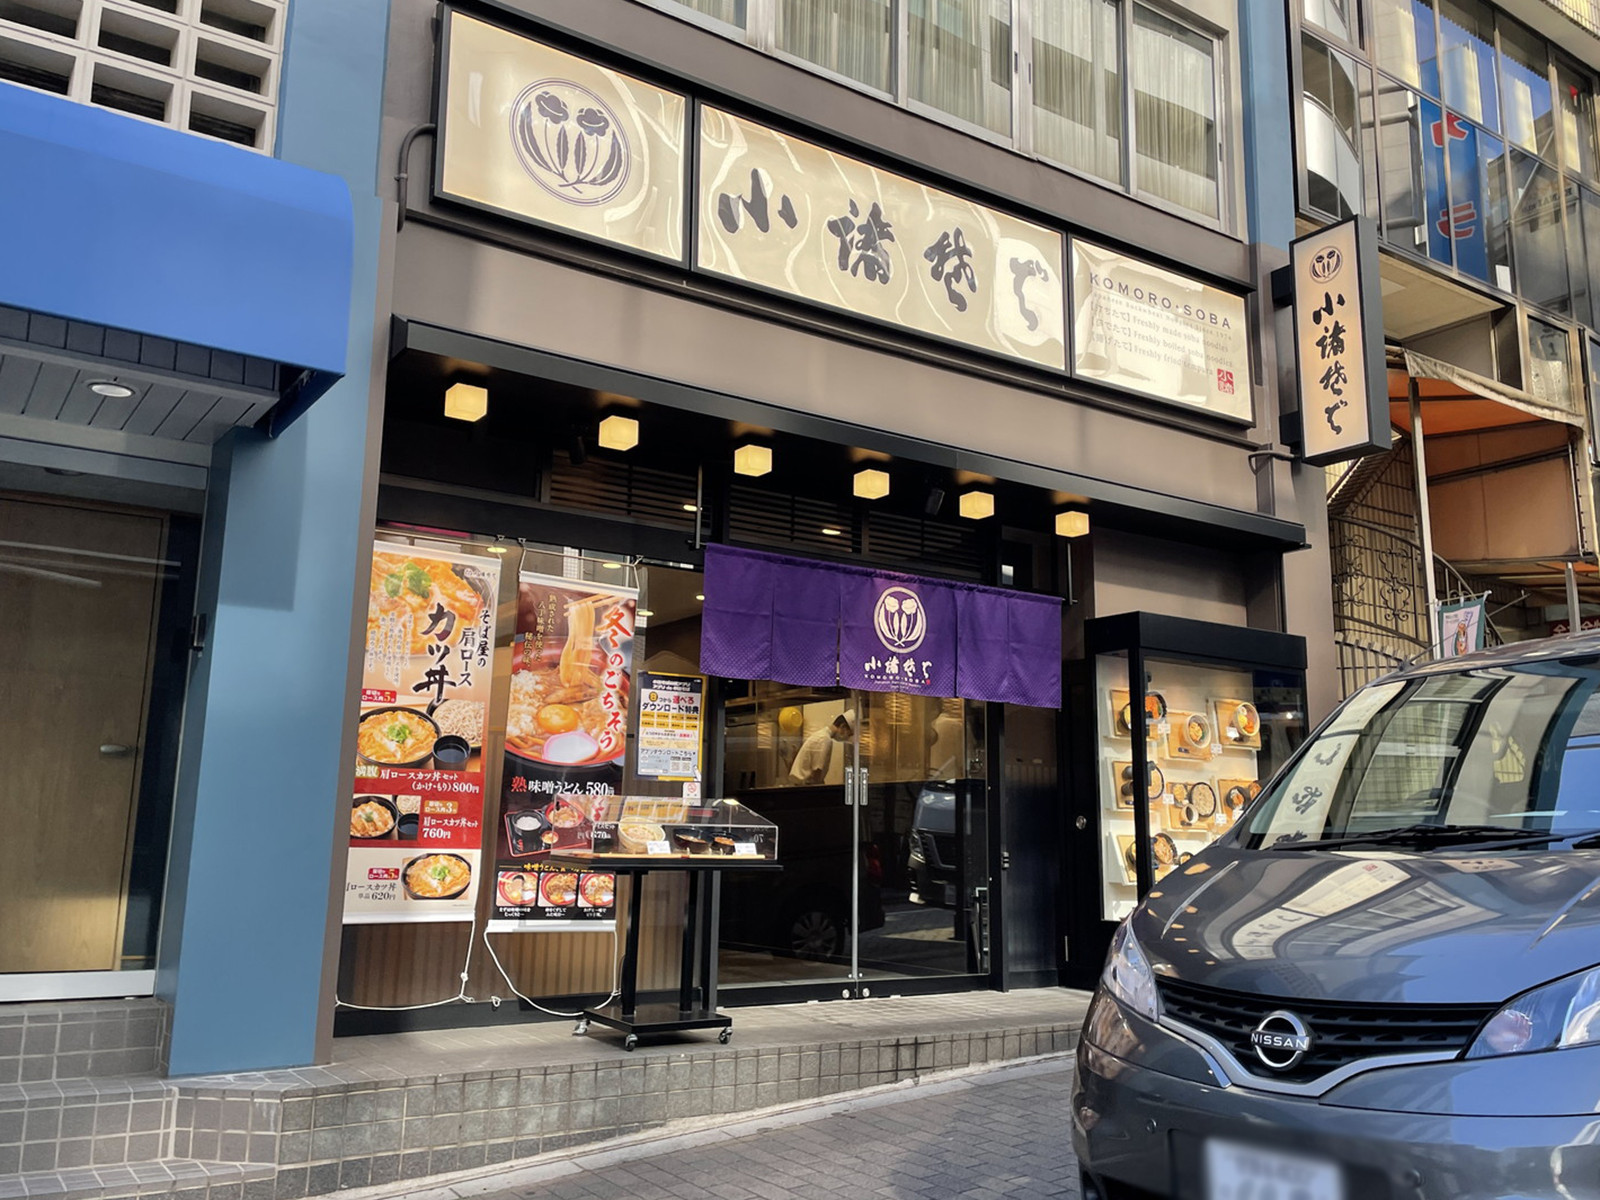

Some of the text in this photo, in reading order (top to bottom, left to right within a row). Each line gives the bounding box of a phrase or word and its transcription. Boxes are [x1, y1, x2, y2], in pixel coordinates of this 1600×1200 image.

[412, 602, 457, 703] カツ丼
[458, 627, 476, 687] 肩ロース
[477, 609, 491, 668] そば屋の
[595, 605, 632, 750] 冬のごちそう
[641, 702, 700, 715] ダウンロード特典
[422, 827, 452, 840] 760円
[1251, 1032, 1307, 1050] NISSAN
